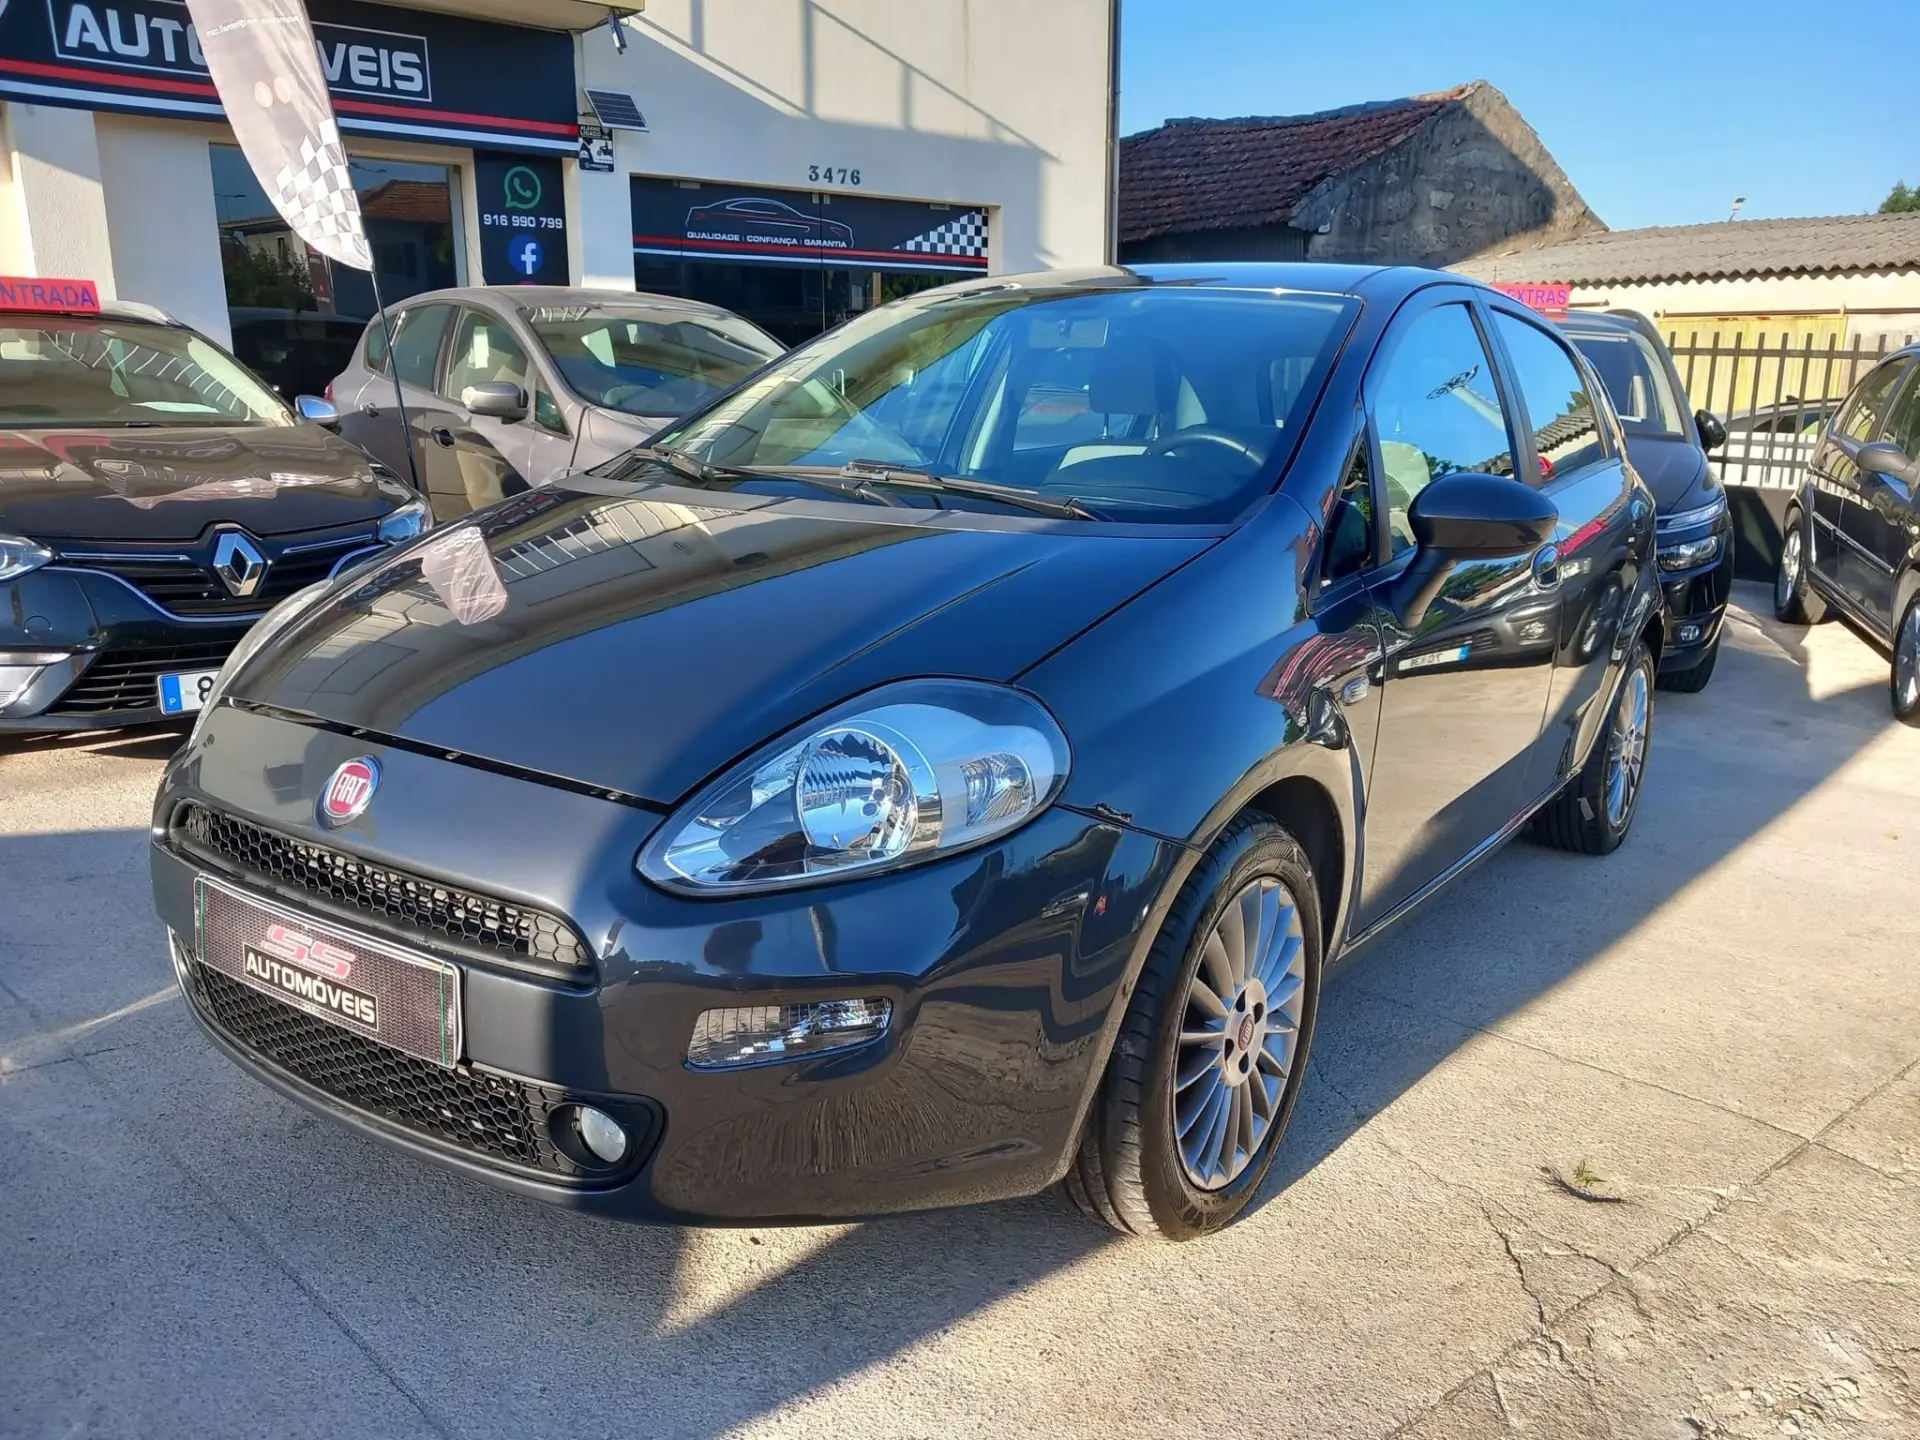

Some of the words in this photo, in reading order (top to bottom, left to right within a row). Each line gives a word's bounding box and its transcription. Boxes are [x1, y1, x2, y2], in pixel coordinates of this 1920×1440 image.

[65, 3, 424, 93] AUTVEIS
[808, 165, 861, 186] 3476
[483, 213, 508, 226] 916
[511, 215, 536, 228] 990
[539, 217, 563, 229] 799
[687, 231, 740, 242] QUALIDADE
[746, 234, 799, 247] CONFIANÇA
[803, 238, 848, 248] GARANTIA
[331, 771, 370, 806] FIAT
[260, 923, 357, 980] SS
[246, 951, 376, 1024] AUTOMÓVEIS
